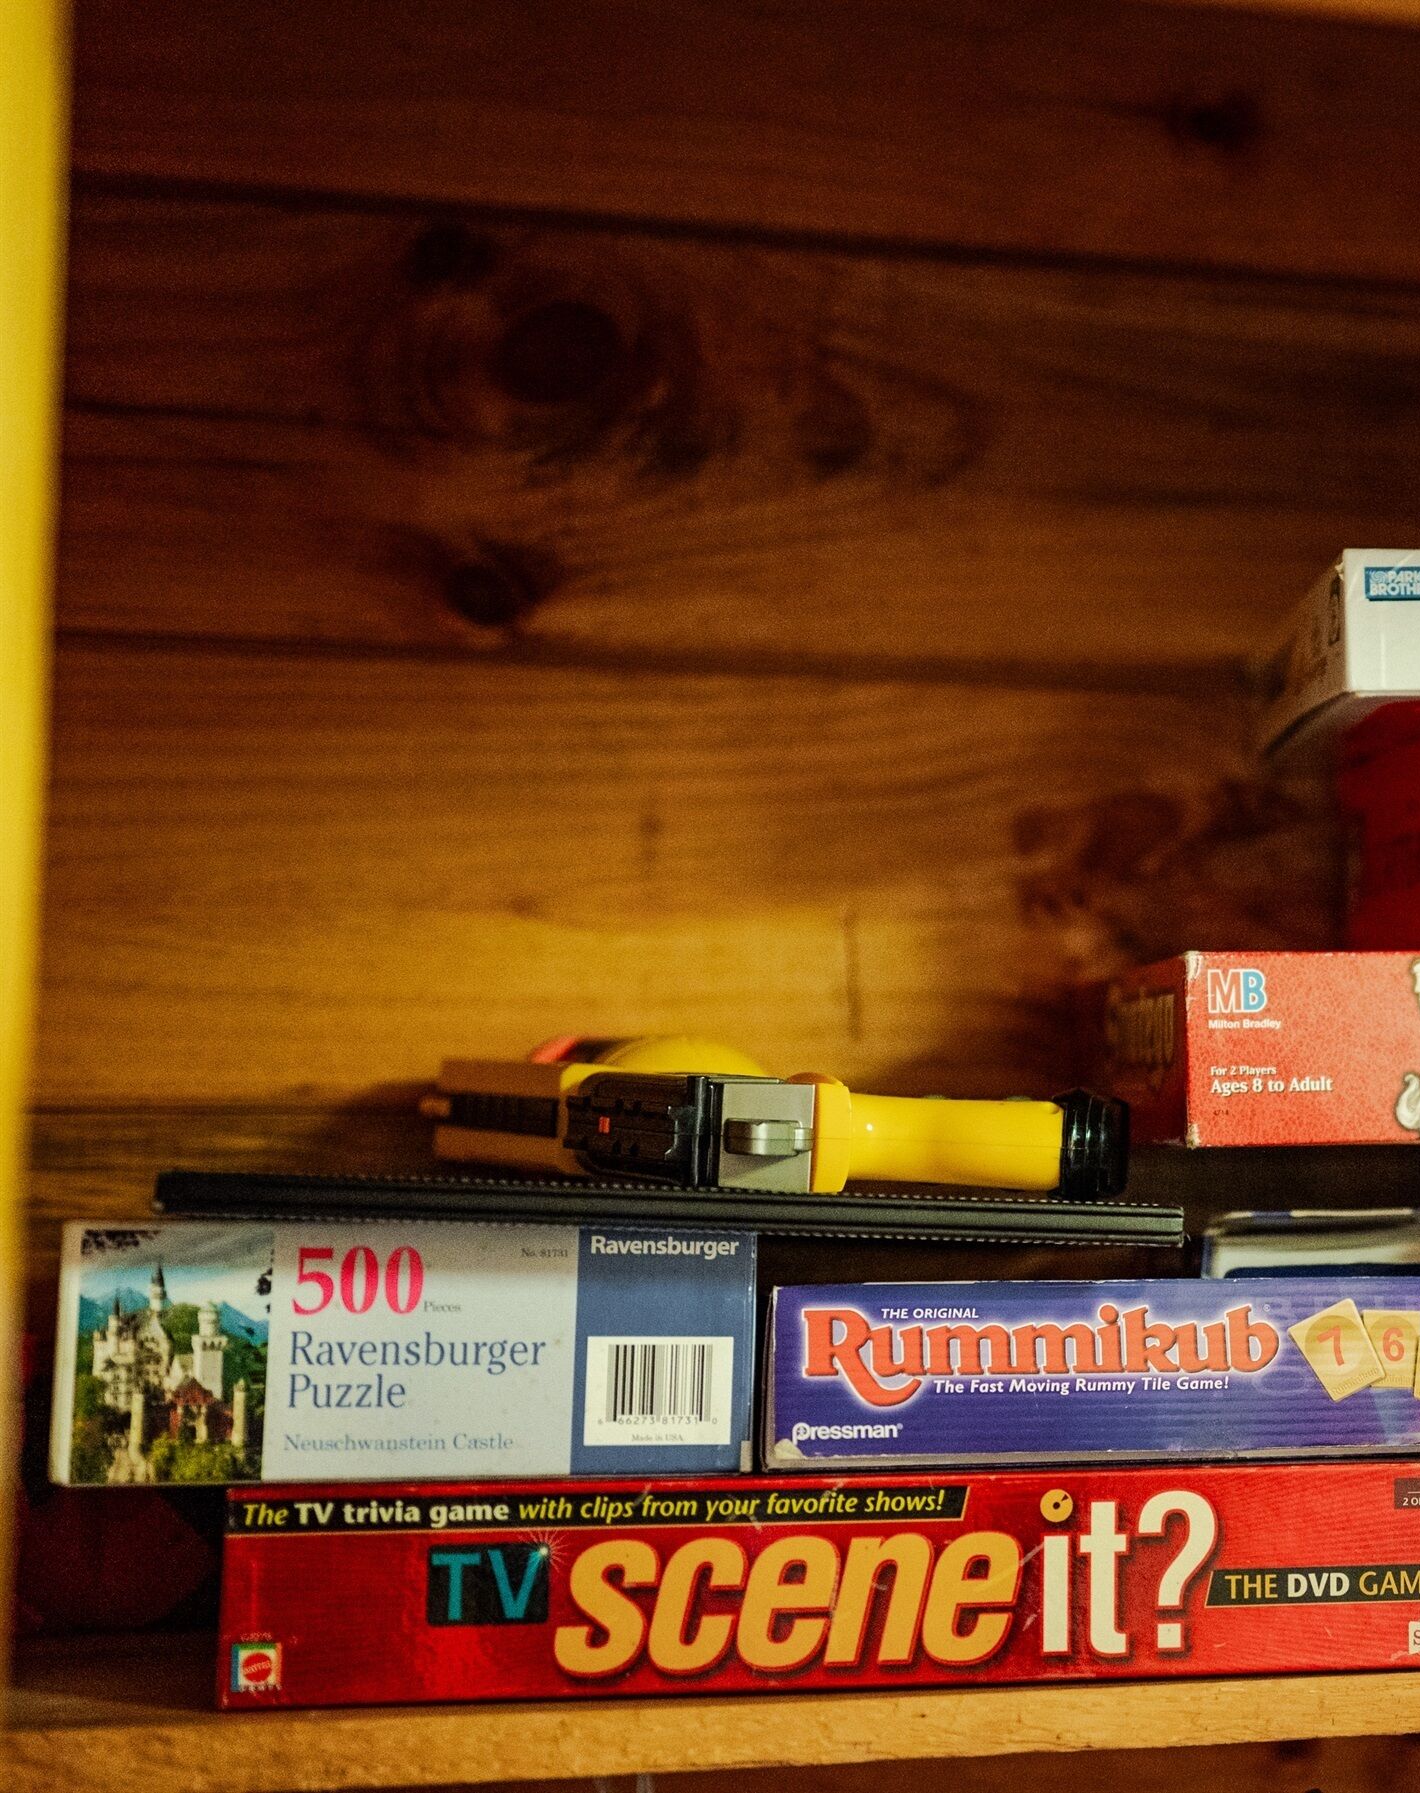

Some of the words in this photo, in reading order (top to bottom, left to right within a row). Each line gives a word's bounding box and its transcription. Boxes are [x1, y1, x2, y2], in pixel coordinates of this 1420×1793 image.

[1207, 968, 1267, 1014] MB
[1208, 1019, 1240, 1029] Milton
[1243, 1018, 1281, 1030] Bradley
[1210, 1066, 1227, 1075] For
[1230, 1066, 1236, 1075] 2
[1239, 1065, 1277, 1077] Players
[1210, 1079, 1248, 1096] Ages
[1252, 1078, 1263, 1092] 8
[1267, 1080, 1285, 1092] to
[1289, 1076, 1333, 1092] Adult
[590, 1235, 740, 1259] Ravensburger
[291, 1245, 425, 1315] 500
[424, 1301, 462, 1313] Pieces
[881, 1308, 908, 1319] THE
[912, 1307, 979, 1319] ORIGINAL
[288, 1330, 546, 1375] Ravensburger
[803, 1303, 1280, 1408] Rummikub
[1316, 1325, 1346, 1367] 7
[1382, 1327, 1405, 1362] 6
[287, 1372, 406, 1409] Puzzle
[934, 1379, 965, 1394] The
[970, 1379, 1004, 1393] Fast
[1009, 1378, 1070, 1395] Moving
[1075, 1378, 1136, 1395] Rummy
[1141, 1376, 1171, 1391] Tile
[1176, 1376, 1230, 1391] Game!
[283, 1433, 446, 1451] Neuschwanstein
[452, 1432, 513, 1451] Castle
[243, 1503, 289, 1525] The
[294, 1502, 335, 1524] TV
[343, 1500, 422, 1524] trivia
[429, 1503, 509, 1529] game
[519, 1496, 573, 1520] with
[580, 1496, 634, 1523] clips
[641, 1495, 697, 1518] from
[706, 1498, 758, 1522] your
[766, 1491, 857, 1515] favorite
[864, 1489, 945, 1512] shows!
[1402, 1498, 1409, 1506] 2
[431, 1548, 547, 1621] TV
[553, 1531, 1021, 1677] scene
[1039, 1488, 1217, 1656] it?
[1224, 1574, 1278, 1599] THE
[1287, 1571, 1350, 1598] DVD
